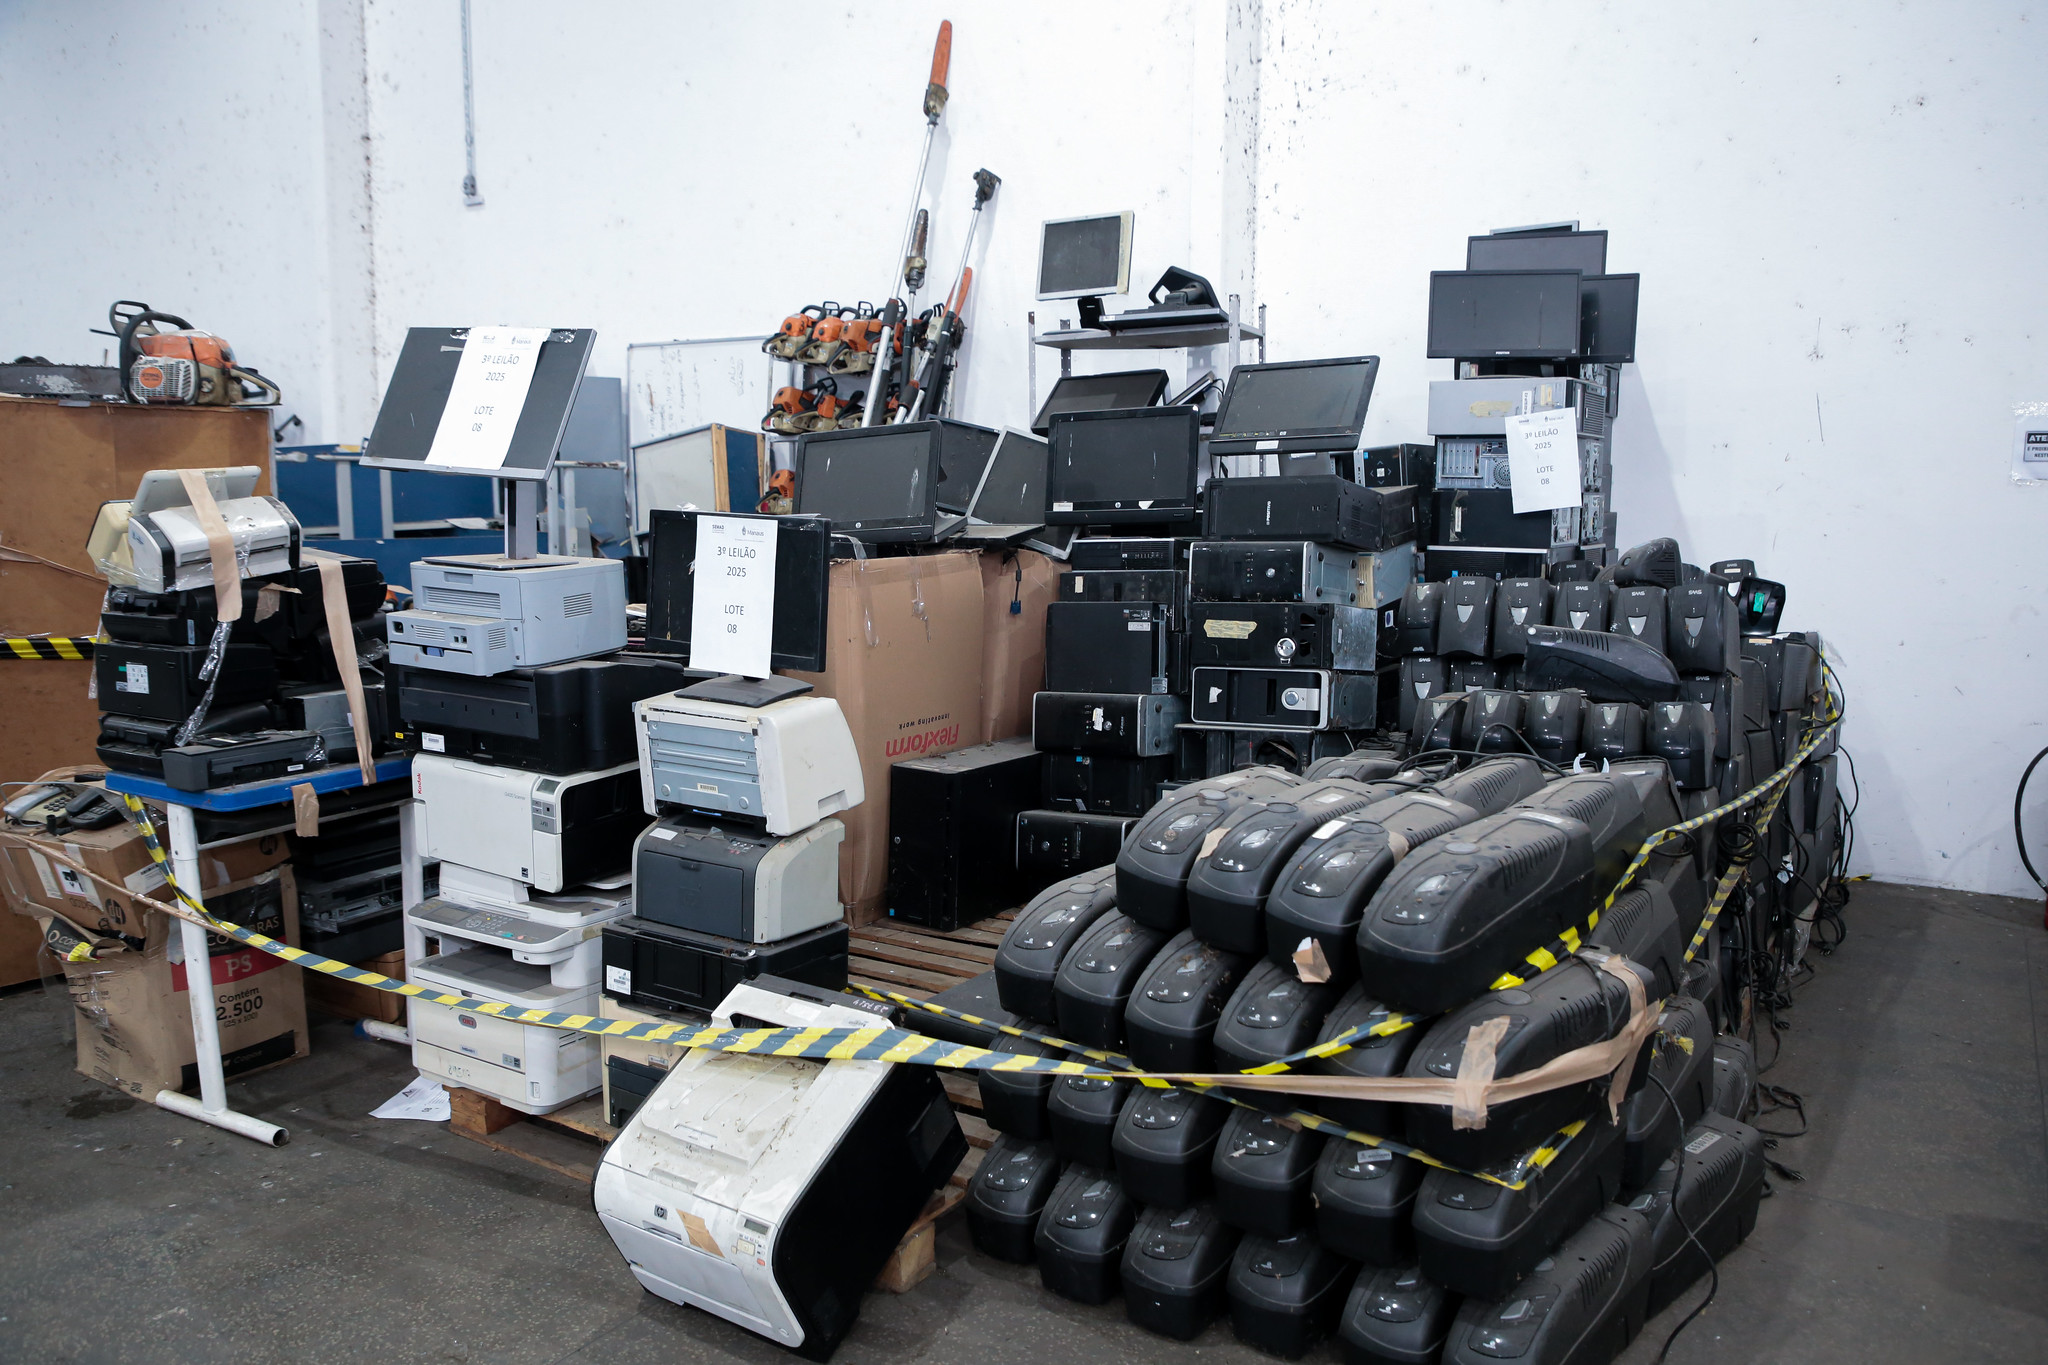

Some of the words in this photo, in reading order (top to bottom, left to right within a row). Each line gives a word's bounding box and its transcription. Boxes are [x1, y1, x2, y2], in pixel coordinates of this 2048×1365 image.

[492, 353, 520, 365] LEILÃO
[485, 371, 506, 382] 2025
[473, 405, 495, 416] LOTE
[471, 422, 483, 432] 08
[1534, 427, 1559, 438] LEILÃO
[1534, 441, 1552, 450] 2025
[1536, 465, 1554, 474] LOTE
[717, 545, 727, 556] 3º
[728, 546, 756, 559] LEILÃO
[726, 565, 748, 578] 2025
[724, 604, 745, 616] LOTE
[726, 623, 738, 634] 08
[917, 712, 951, 726] innovating
[898, 720, 916, 731] work
[885, 723, 960, 758] Flexform
[224, 954, 253, 977] PS
[218, 987, 260, 1004] Contém
[216, 995, 264, 1021] 2.500
